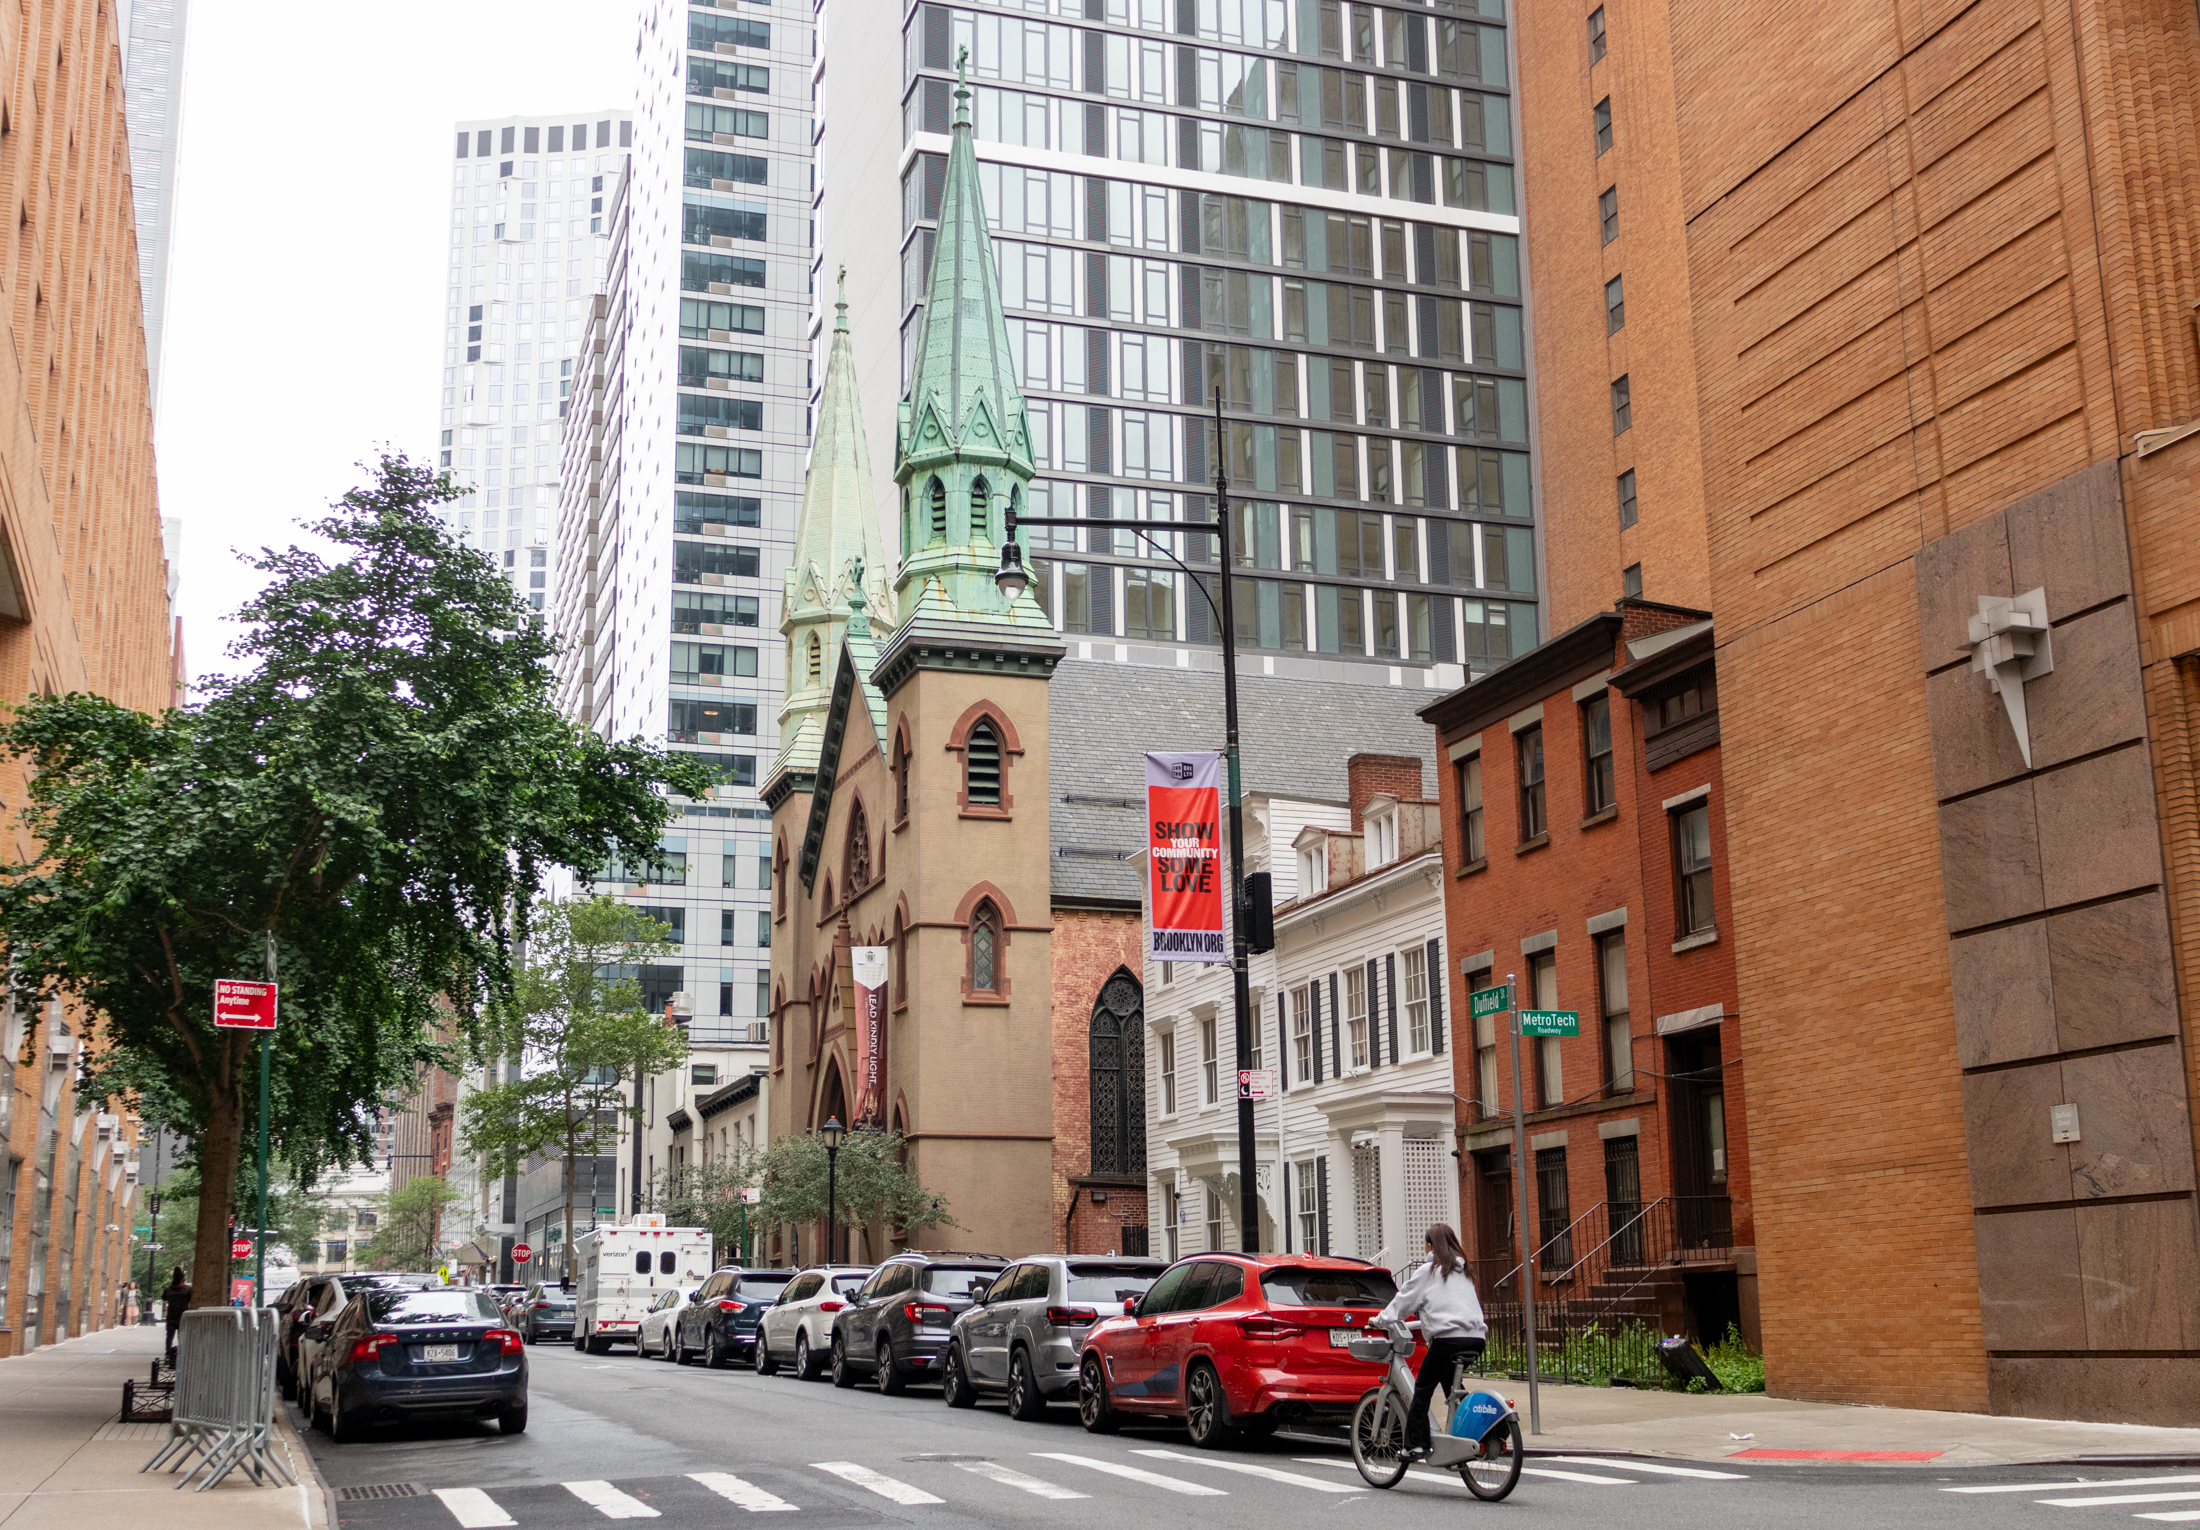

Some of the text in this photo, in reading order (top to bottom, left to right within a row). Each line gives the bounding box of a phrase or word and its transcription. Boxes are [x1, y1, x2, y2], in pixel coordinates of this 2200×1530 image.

[1155, 821, 1214, 840] SHOW
[1170, 838, 1200, 848] YOUR
[1152, 847, 1218, 858] COMMUNITY
[1158, 856, 1213, 874] SOME
[1161, 874, 1212, 893] LOVE
[1153, 932, 1224, 953] BROOKLYN ORG
[219, 985, 267, 996] NO STANDING
[220, 995, 250, 1006] Anytime
[1474, 989, 1505, 1014] Duffield St
[1523, 1013, 1575, 1026] MetroTech
[232, 1244, 251, 1252] STOP
[513, 1249, 531, 1257] STOP
